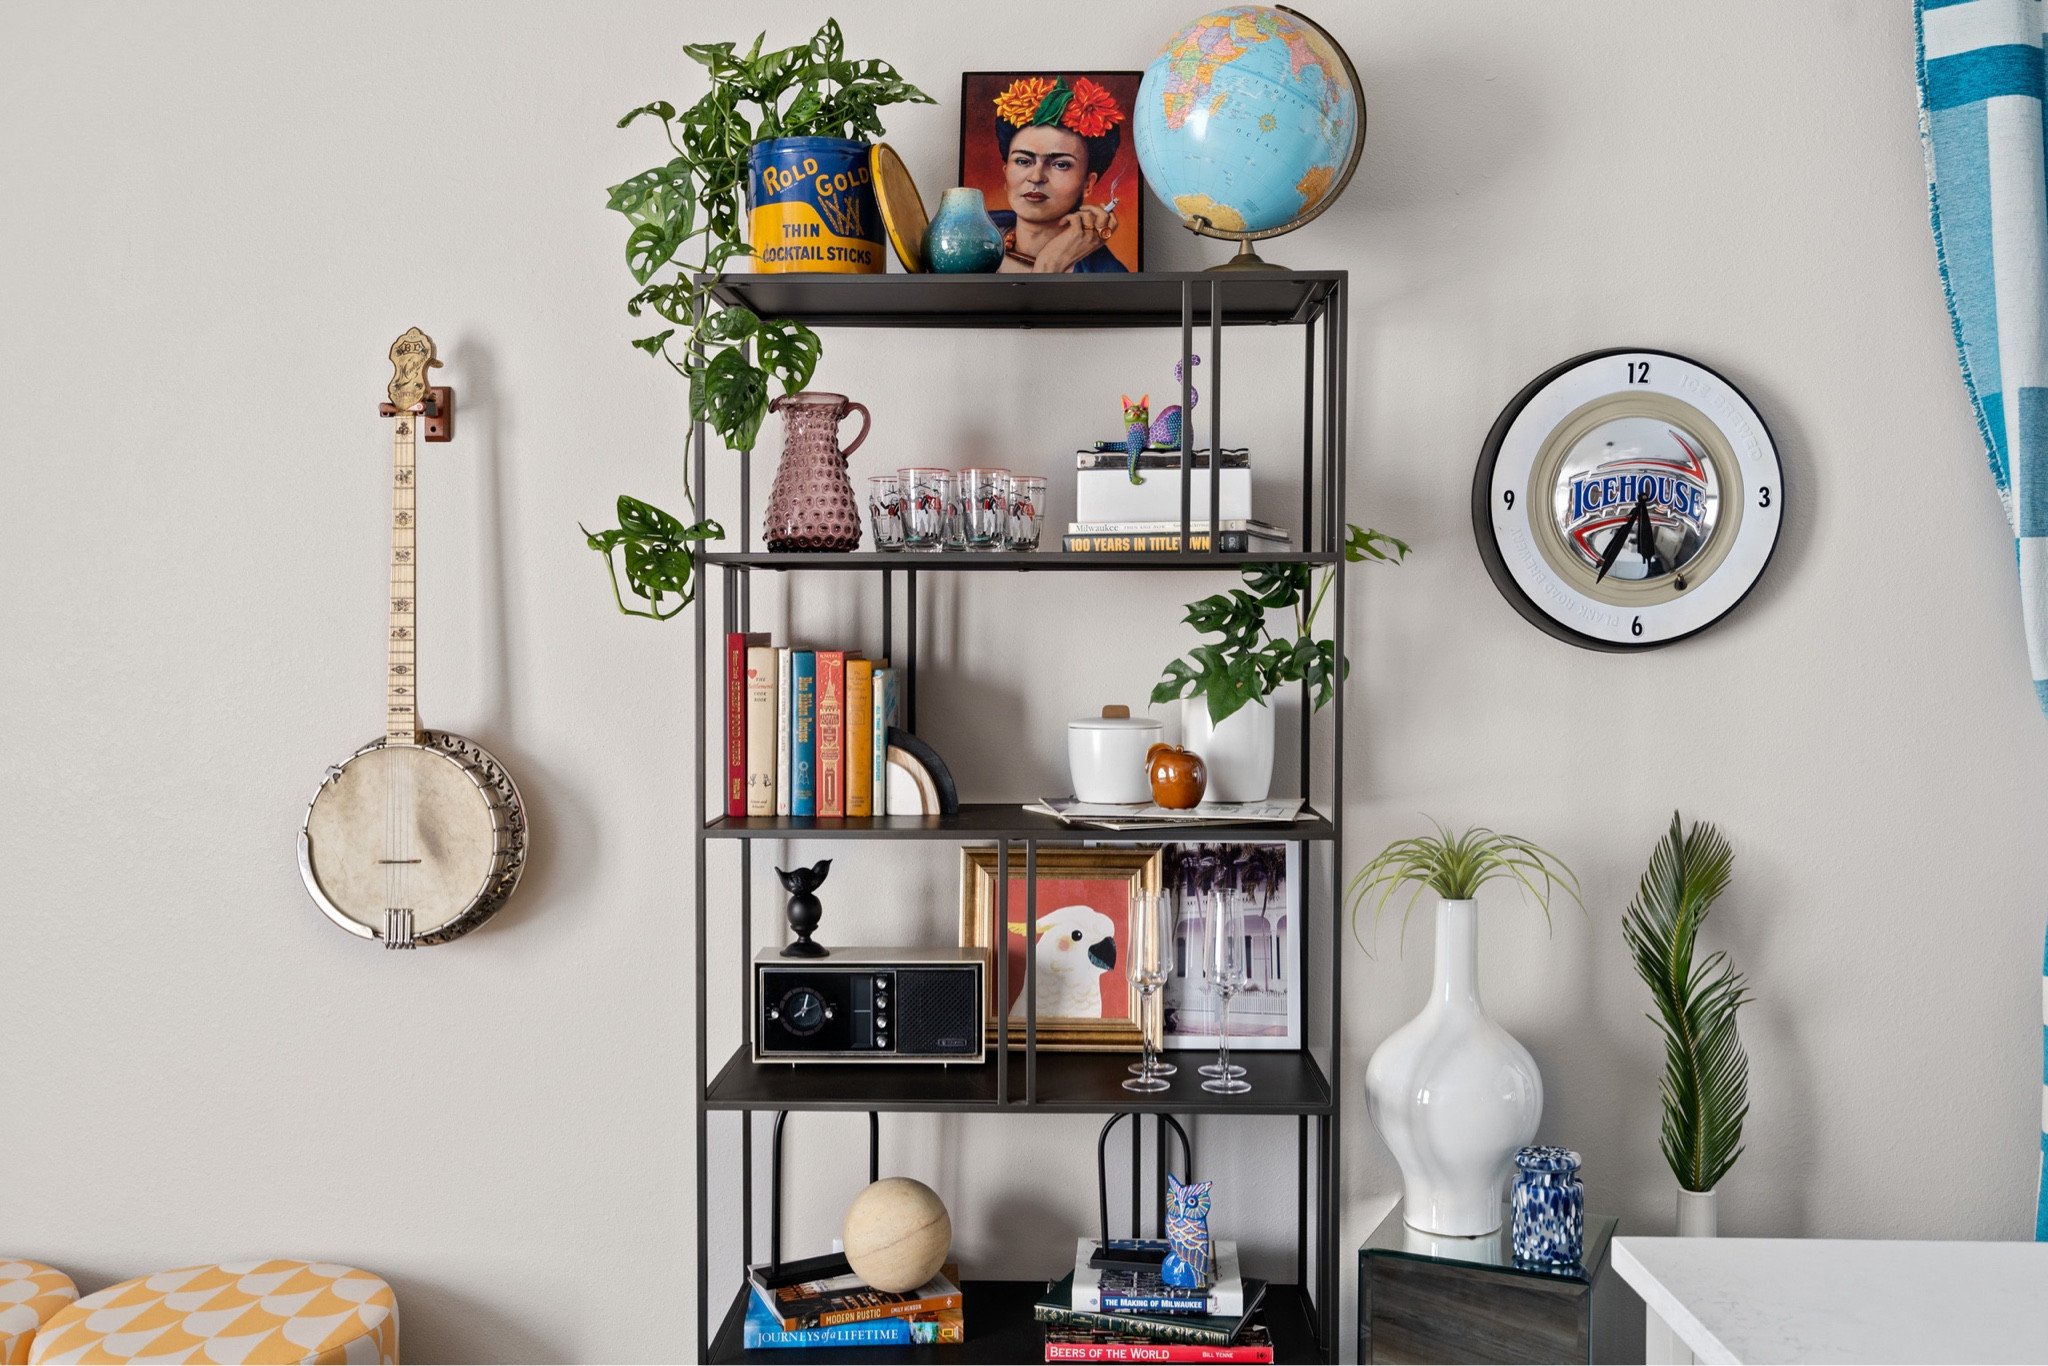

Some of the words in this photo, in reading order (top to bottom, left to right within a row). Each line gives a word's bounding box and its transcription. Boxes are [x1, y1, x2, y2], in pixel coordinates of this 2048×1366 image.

[763, 158, 818, 197] ROLD
[815, 167, 869, 197] GOLD
[782, 223, 820, 238] THIN
[826, 246, 871, 265] STICKS
[1627, 362, 1650, 384] 12
[1681, 374, 1711, 398] ICE
[1503, 490, 1515, 511] 9
[1573, 475, 1702, 521] ICEHOUSE
[1758, 486, 1771, 508] 3
[1075, 524, 1119, 533] Milwaukee
[1070, 538, 1090, 552] 100
[1093, 537, 1130, 552] YEARS
[1134, 537, 1146, 551] IN
[1631, 615, 1643, 637] 6
[798, 676, 813, 691] Blue
[731, 681, 741, 712] SECRET
[798, 693, 813, 716] Ribbon
[731, 713, 741, 737] FOOD
[795, 717, 813, 743] Recipes
[731, 740, 741, 766] CURES
[825, 1313, 855, 1325] MODERN
[856, 1309, 881, 1321] RUSTIC
[890, 1306, 903, 1314] EMILY
[904, 1304, 922, 1312] HENSON
[1105, 1299, 1119, 1307] THE
[1120, 1299, 1149, 1308] MAKING
[1150, 1300, 1160, 1308] OF
[1161, 1299, 1203, 1309] MILWAUKEE
[757, 1330, 820, 1346] JOURNEYS
[821, 1329, 831, 1341] of
[830, 1331, 836, 1339] a
[837, 1328, 899, 1341] LIFETIME
[1050, 1346, 1087, 1358] BEERS
[1088, 1348, 1103, 1359] OF
[1105, 1348, 1127, 1359] THE
[1129, 1347, 1170, 1360] WORLD
[1216, 1351, 1234, 1359] YENNE
